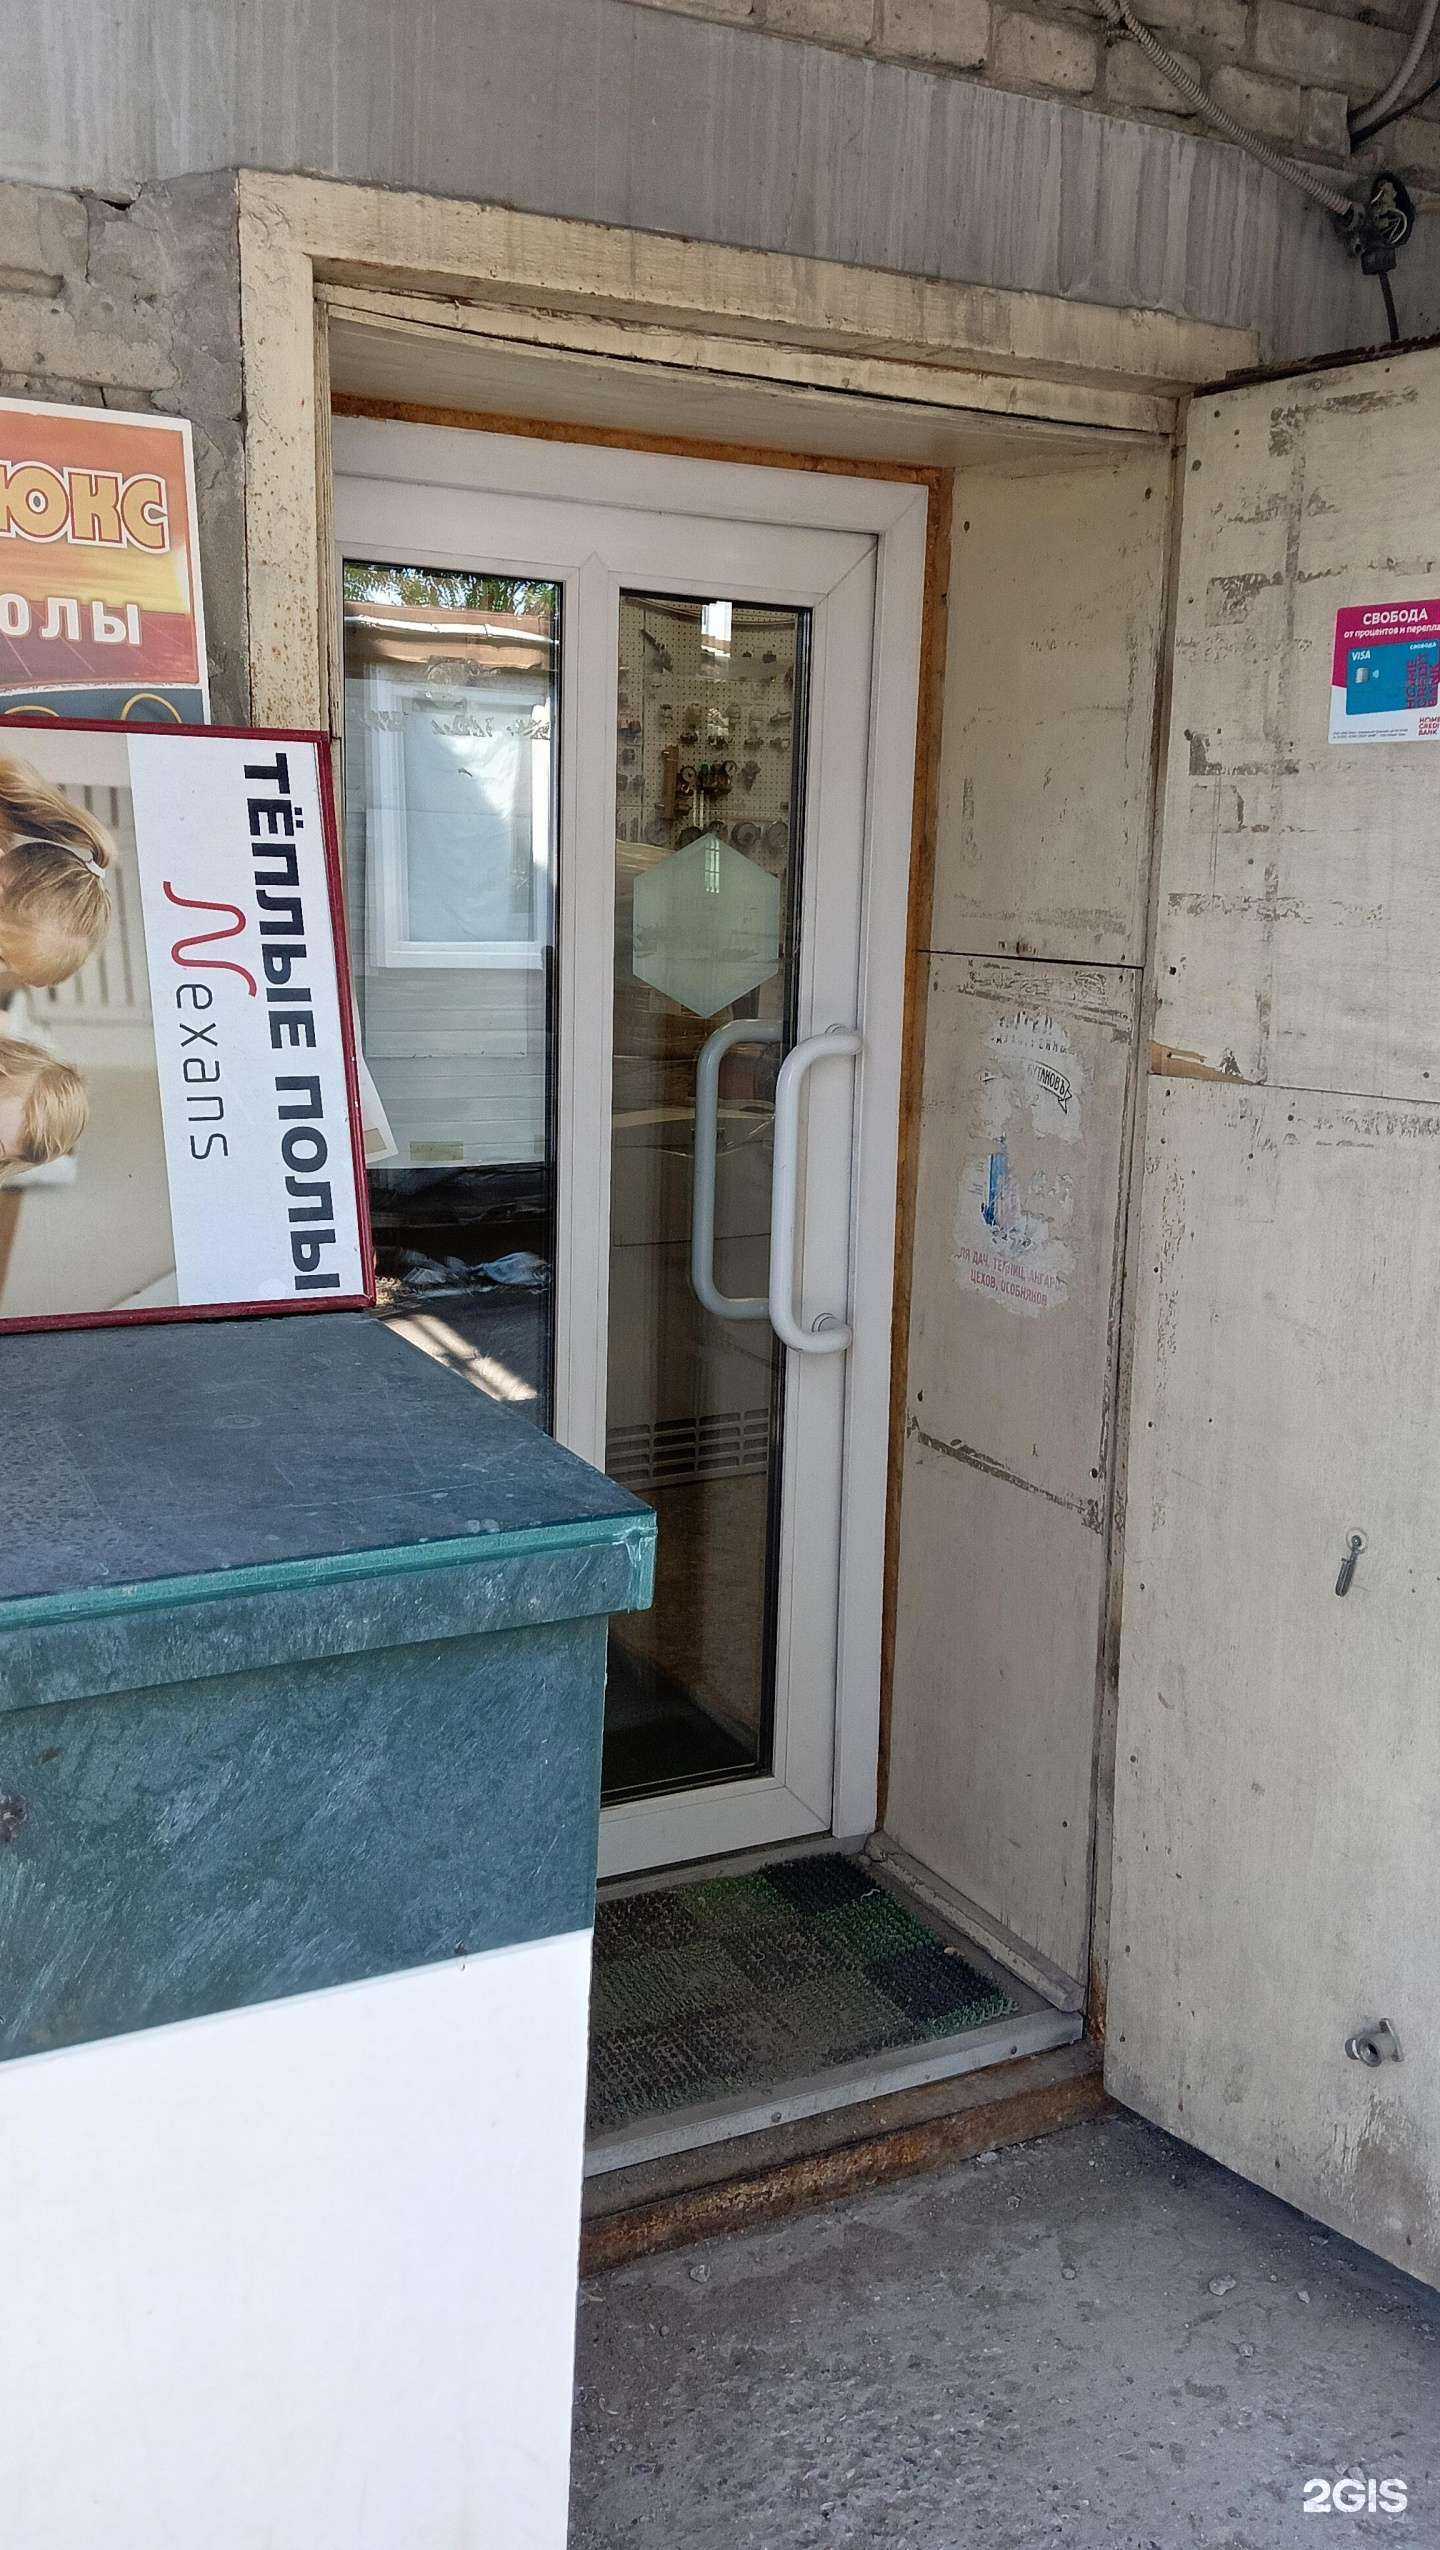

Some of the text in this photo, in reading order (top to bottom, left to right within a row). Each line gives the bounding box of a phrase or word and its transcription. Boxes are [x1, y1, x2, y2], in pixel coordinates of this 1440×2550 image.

[1363, 607, 1429, 625] СВОБОДА
[1344, 630, 1354, 639] от
[1355, 626, 1399, 639] процентов
[1400, 626, 1406, 635] и
[1352, 649, 1371, 661] VISA
[244, 752, 340, 1291] ТЁПЛЫЕ ПОЛЫ
[970, 1268, 1048, 1306] ЦЕХОВ, ОСОБНЯКОВ
